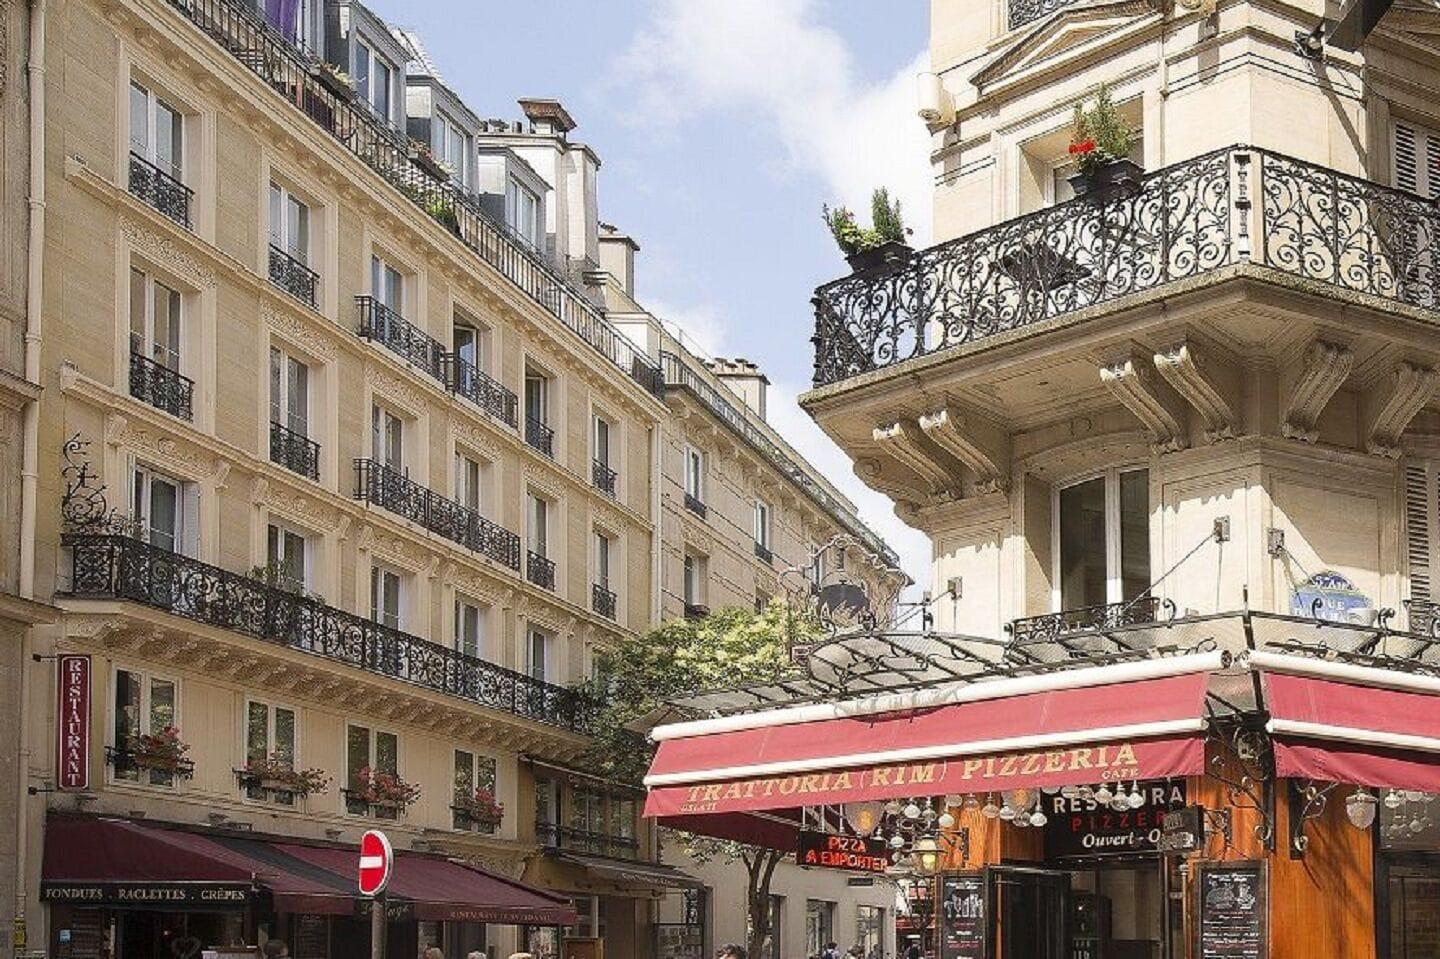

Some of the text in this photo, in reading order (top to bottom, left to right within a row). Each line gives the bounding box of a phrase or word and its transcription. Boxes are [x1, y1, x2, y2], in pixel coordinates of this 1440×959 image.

[67, 660, 82, 786] RESTAURANT
[687, 771, 853, 803] TRATTORIA
[961, 746, 1138, 780] PIZZERIA
[828, 836, 867, 853] PIZZA
[1082, 831, 1134, 848] Ouvert
[821, 851, 888, 871] EMPORTER
[45, 887, 246, 900] FONDUES RACLETTES CRÊPES
